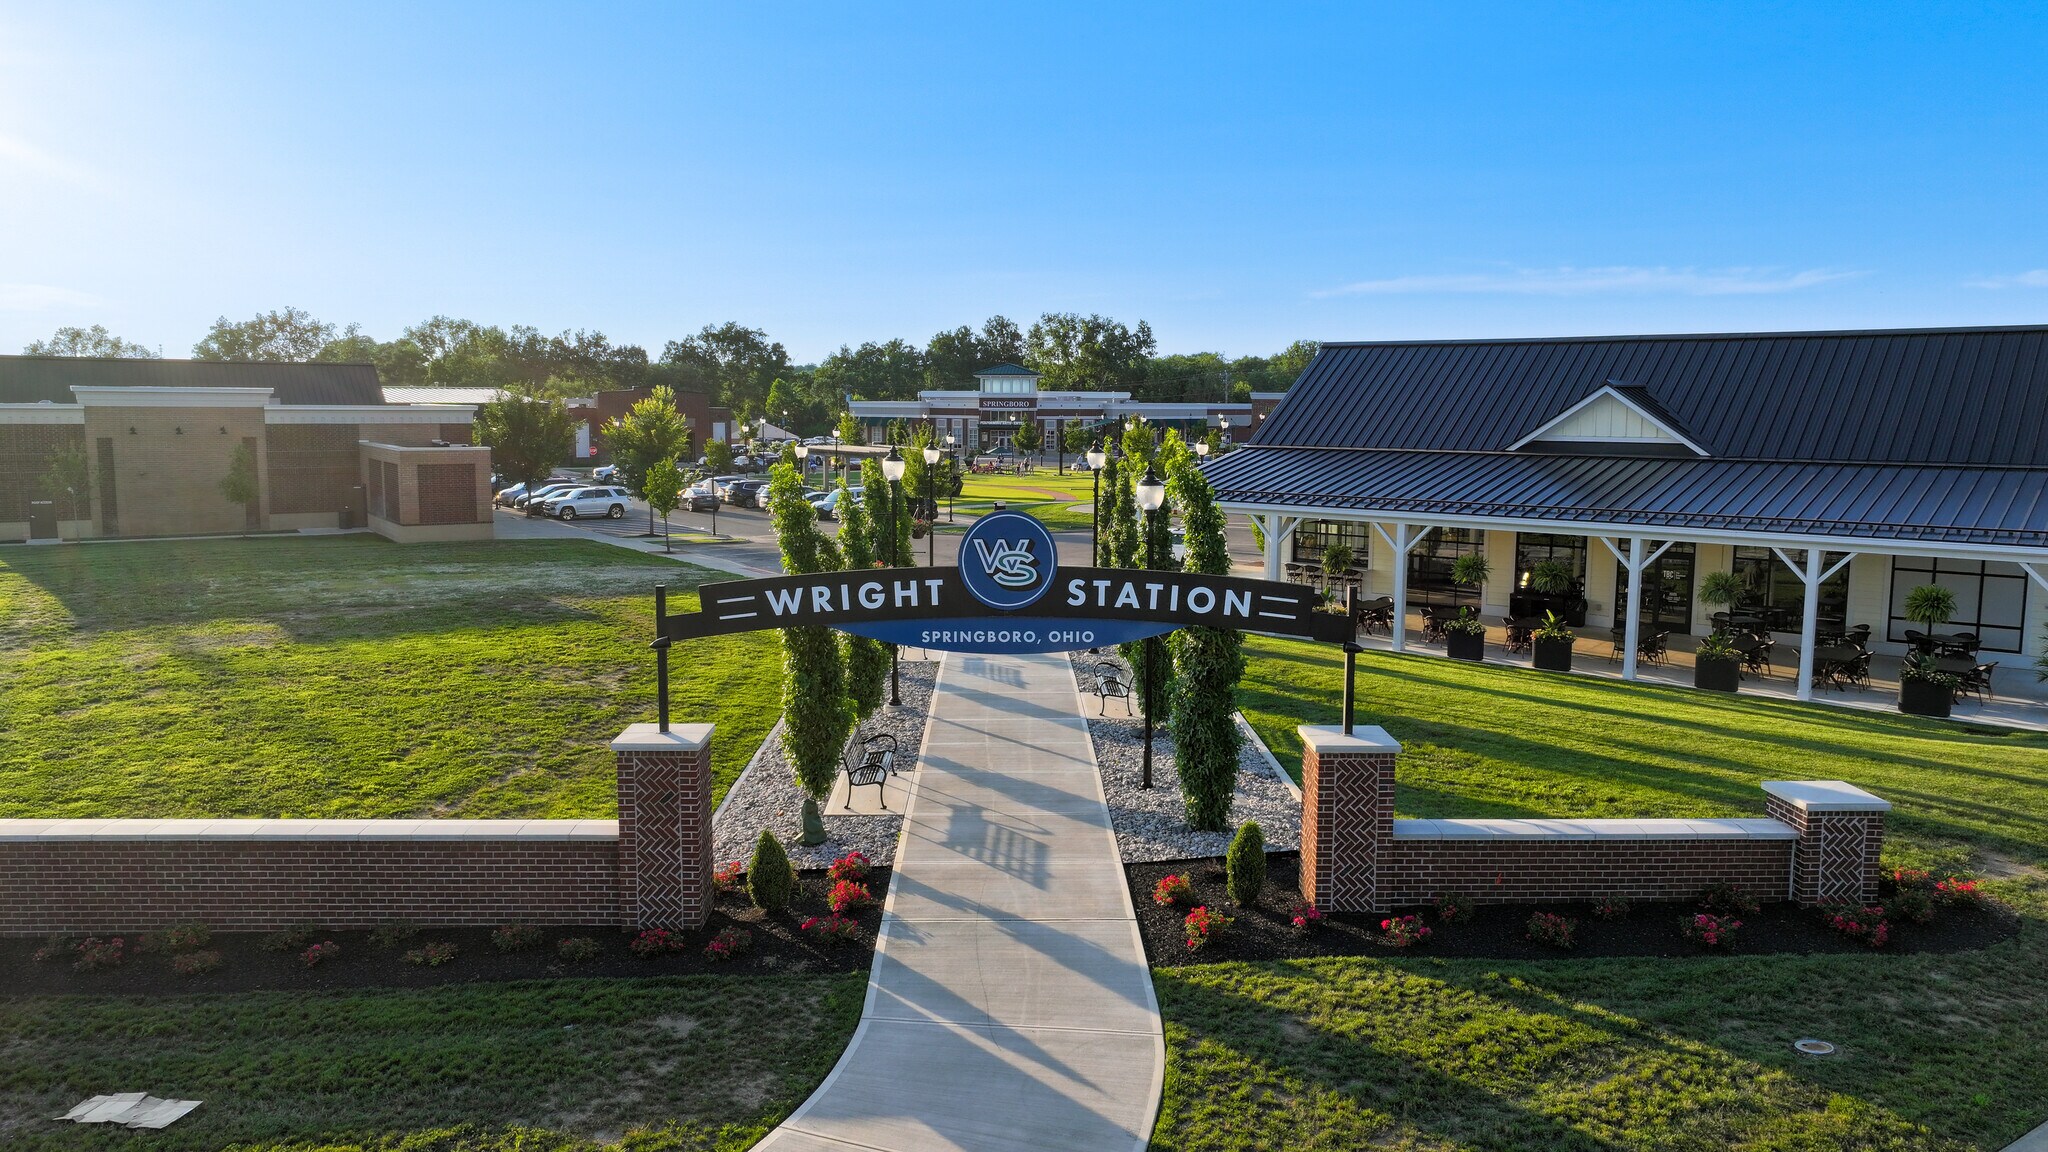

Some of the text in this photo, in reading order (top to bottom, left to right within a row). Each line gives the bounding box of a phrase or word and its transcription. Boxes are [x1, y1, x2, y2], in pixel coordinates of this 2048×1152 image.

[982, 400, 1030, 408] SPRINGBORO
[765, 578, 1252, 618] WRIGHT STATION
[921, 630, 1095, 644] SPRINGBORO, OHIO
